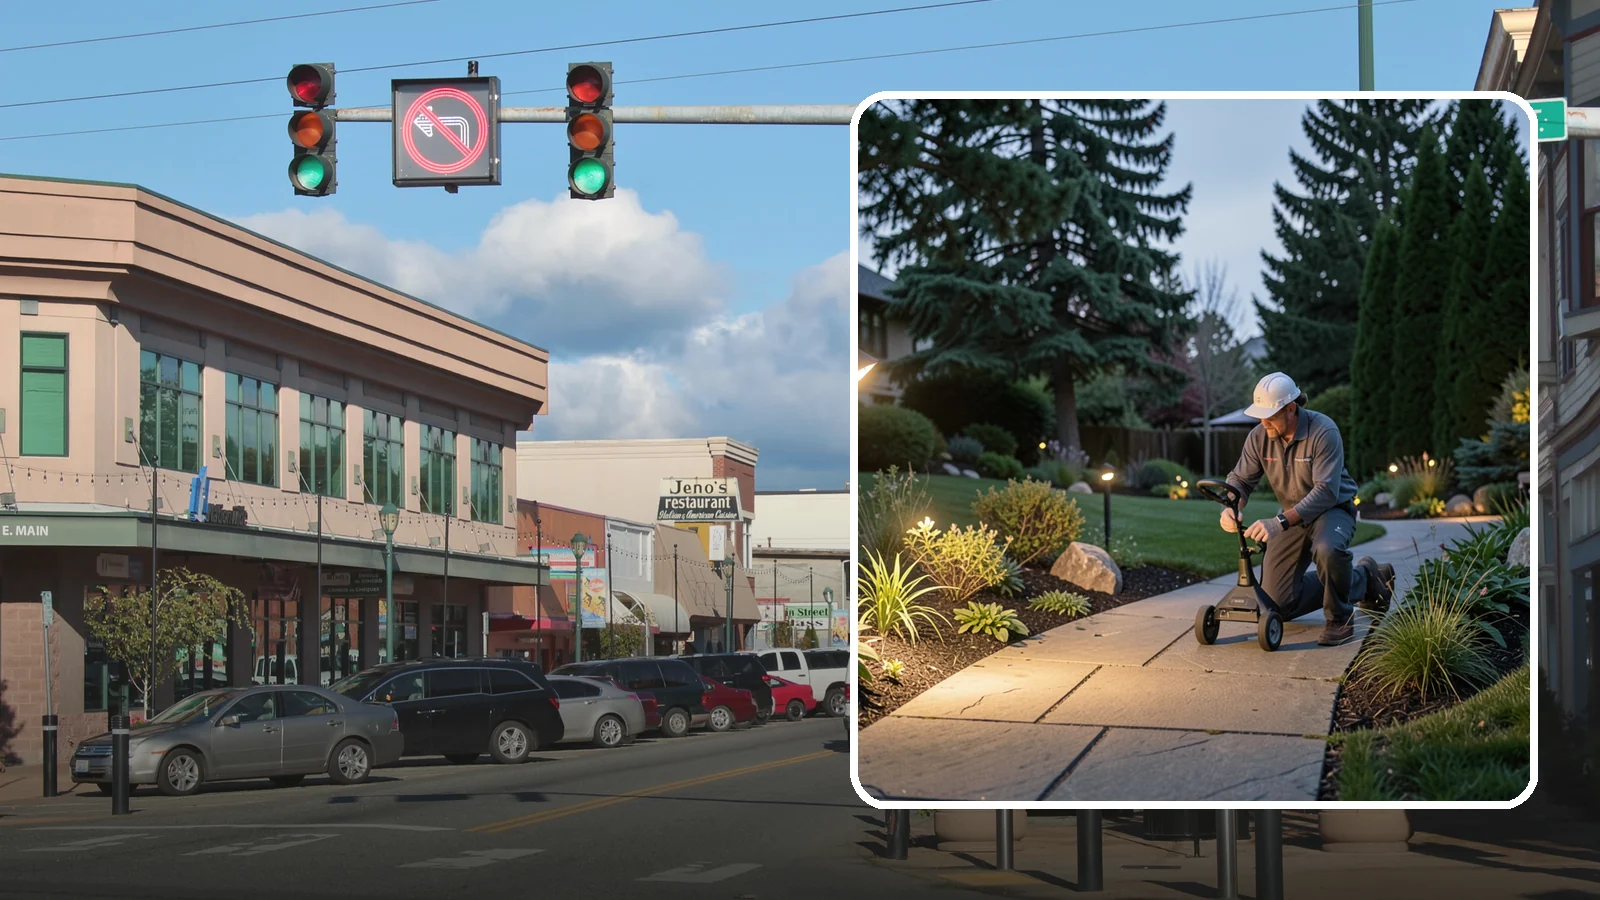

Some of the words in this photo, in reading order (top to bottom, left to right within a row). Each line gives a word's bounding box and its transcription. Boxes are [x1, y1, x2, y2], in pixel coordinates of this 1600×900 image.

[670, 480, 728, 495] Jeno's
[665, 497, 731, 509] restaurant
[686, 510, 715, 519] American
[715, 510, 737, 519] Cuisine
[2, 525, 13, 536] E.
[16, 525, 49, 536] MAIN
[785, 608, 795, 616] in
[797, 607, 829, 617] Street
[790, 619, 824, 627] lass
